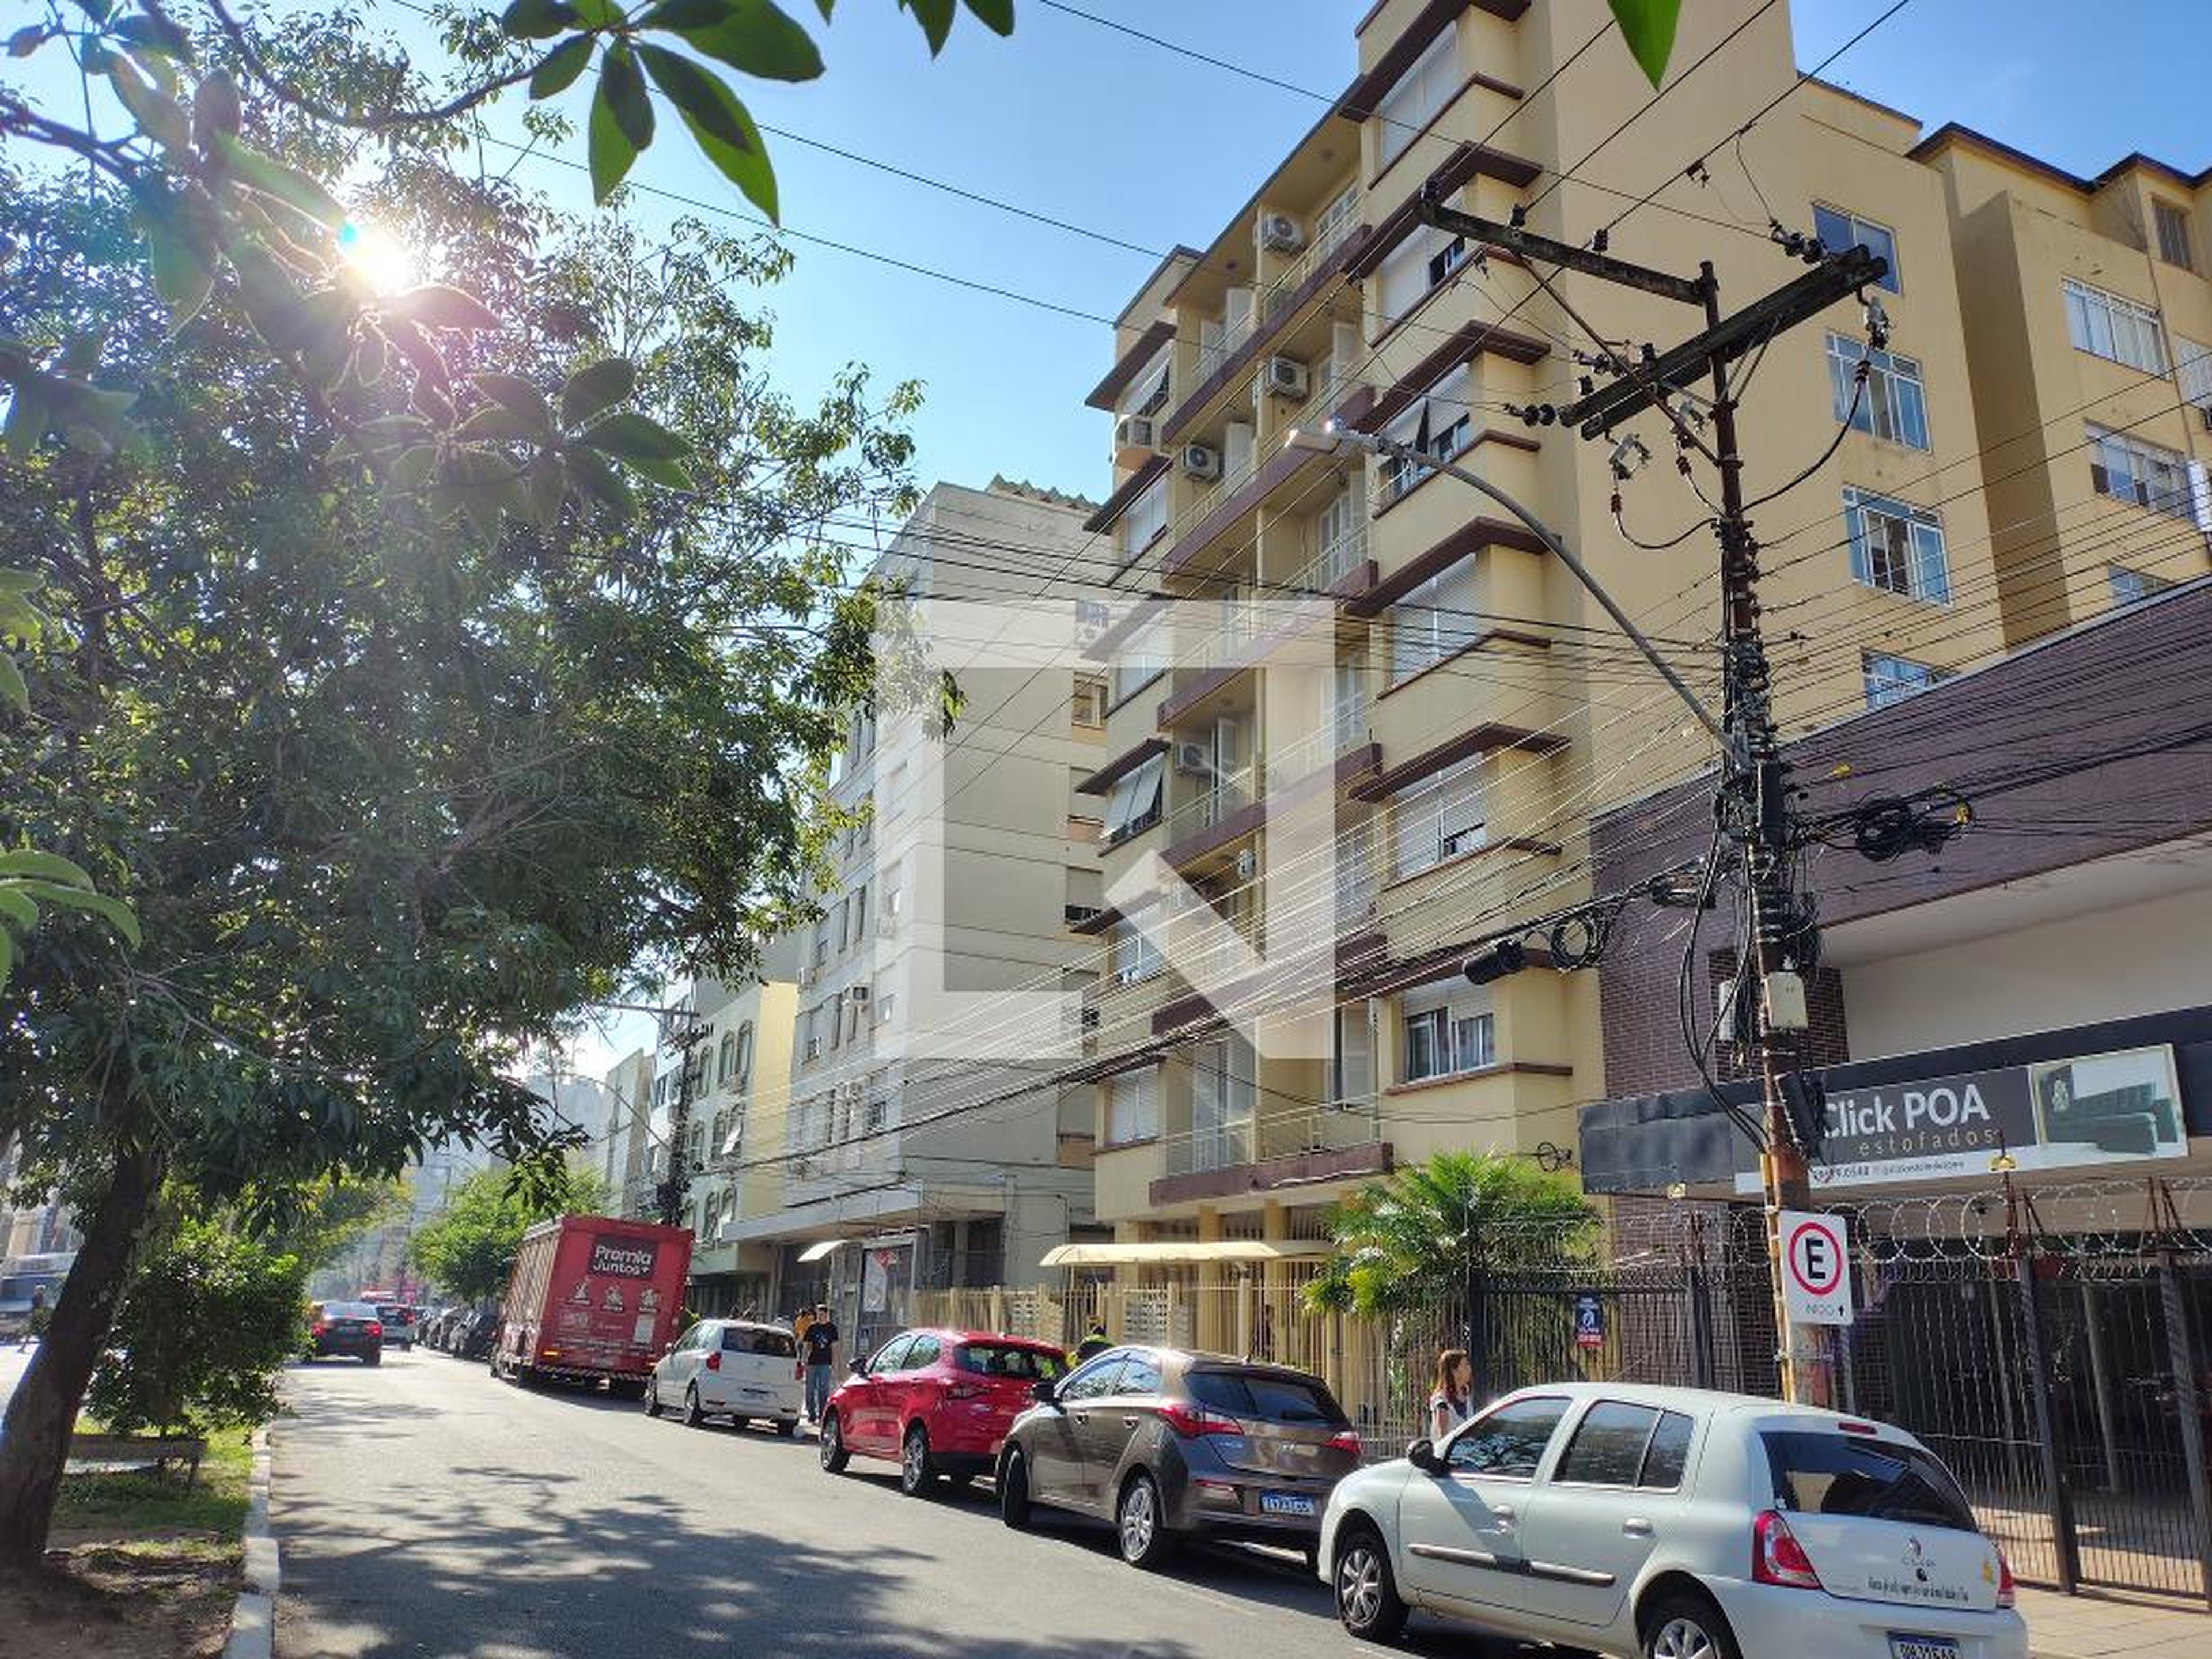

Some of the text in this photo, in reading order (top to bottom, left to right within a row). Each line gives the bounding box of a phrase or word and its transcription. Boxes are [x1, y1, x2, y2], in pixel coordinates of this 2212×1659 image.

[1824, 1083, 1991, 1138] Click POA
[1859, 1127, 1997, 1156] estofados
[1806, 1238, 1825, 1279] E
